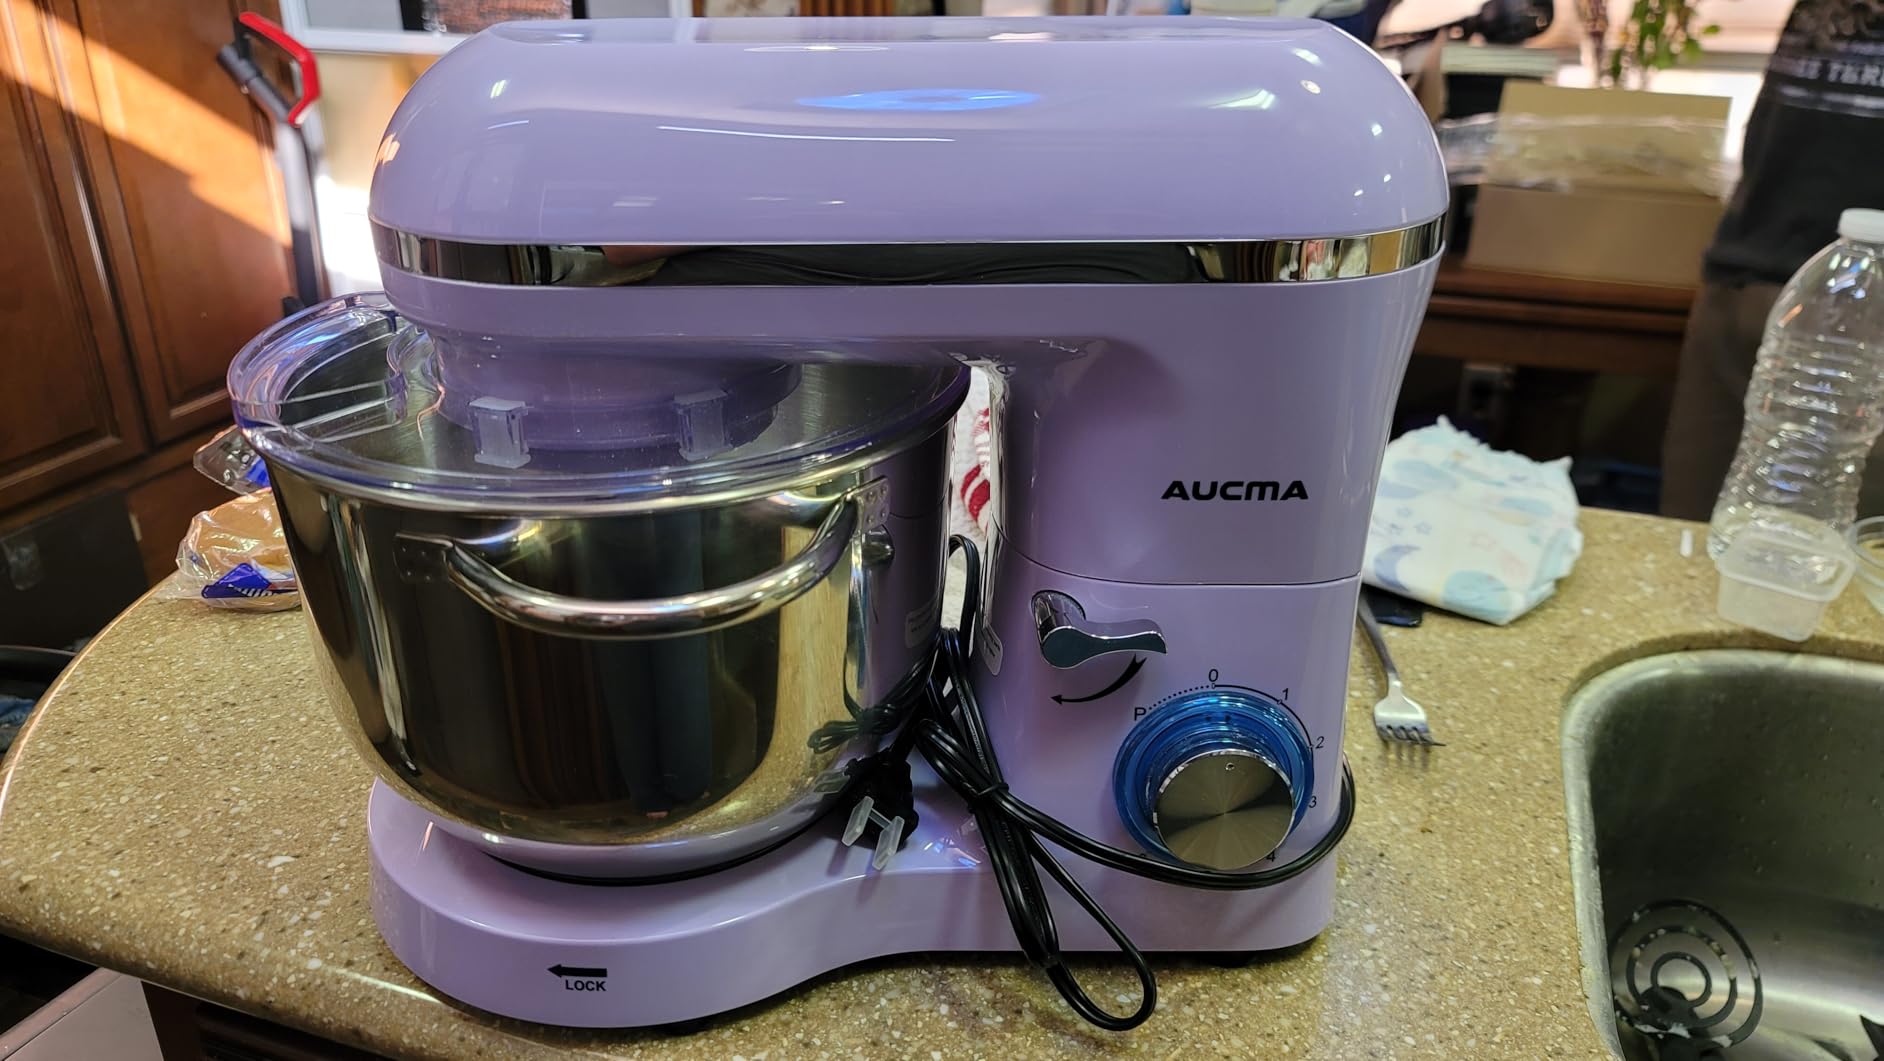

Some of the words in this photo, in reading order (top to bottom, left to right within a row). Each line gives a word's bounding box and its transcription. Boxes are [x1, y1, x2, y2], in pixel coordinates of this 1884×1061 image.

[1161, 480, 1309, 501] AUCMA
[1208, 668, 1219, 683] 0
[1282, 688, 1290, 701] 1
[1134, 706, 1147, 721] P
[1315, 736, 1325, 749] 2
[1308, 795, 1317, 809] 3
[1265, 849, 1276, 862] 4
[565, 979, 606, 992] LOCK
